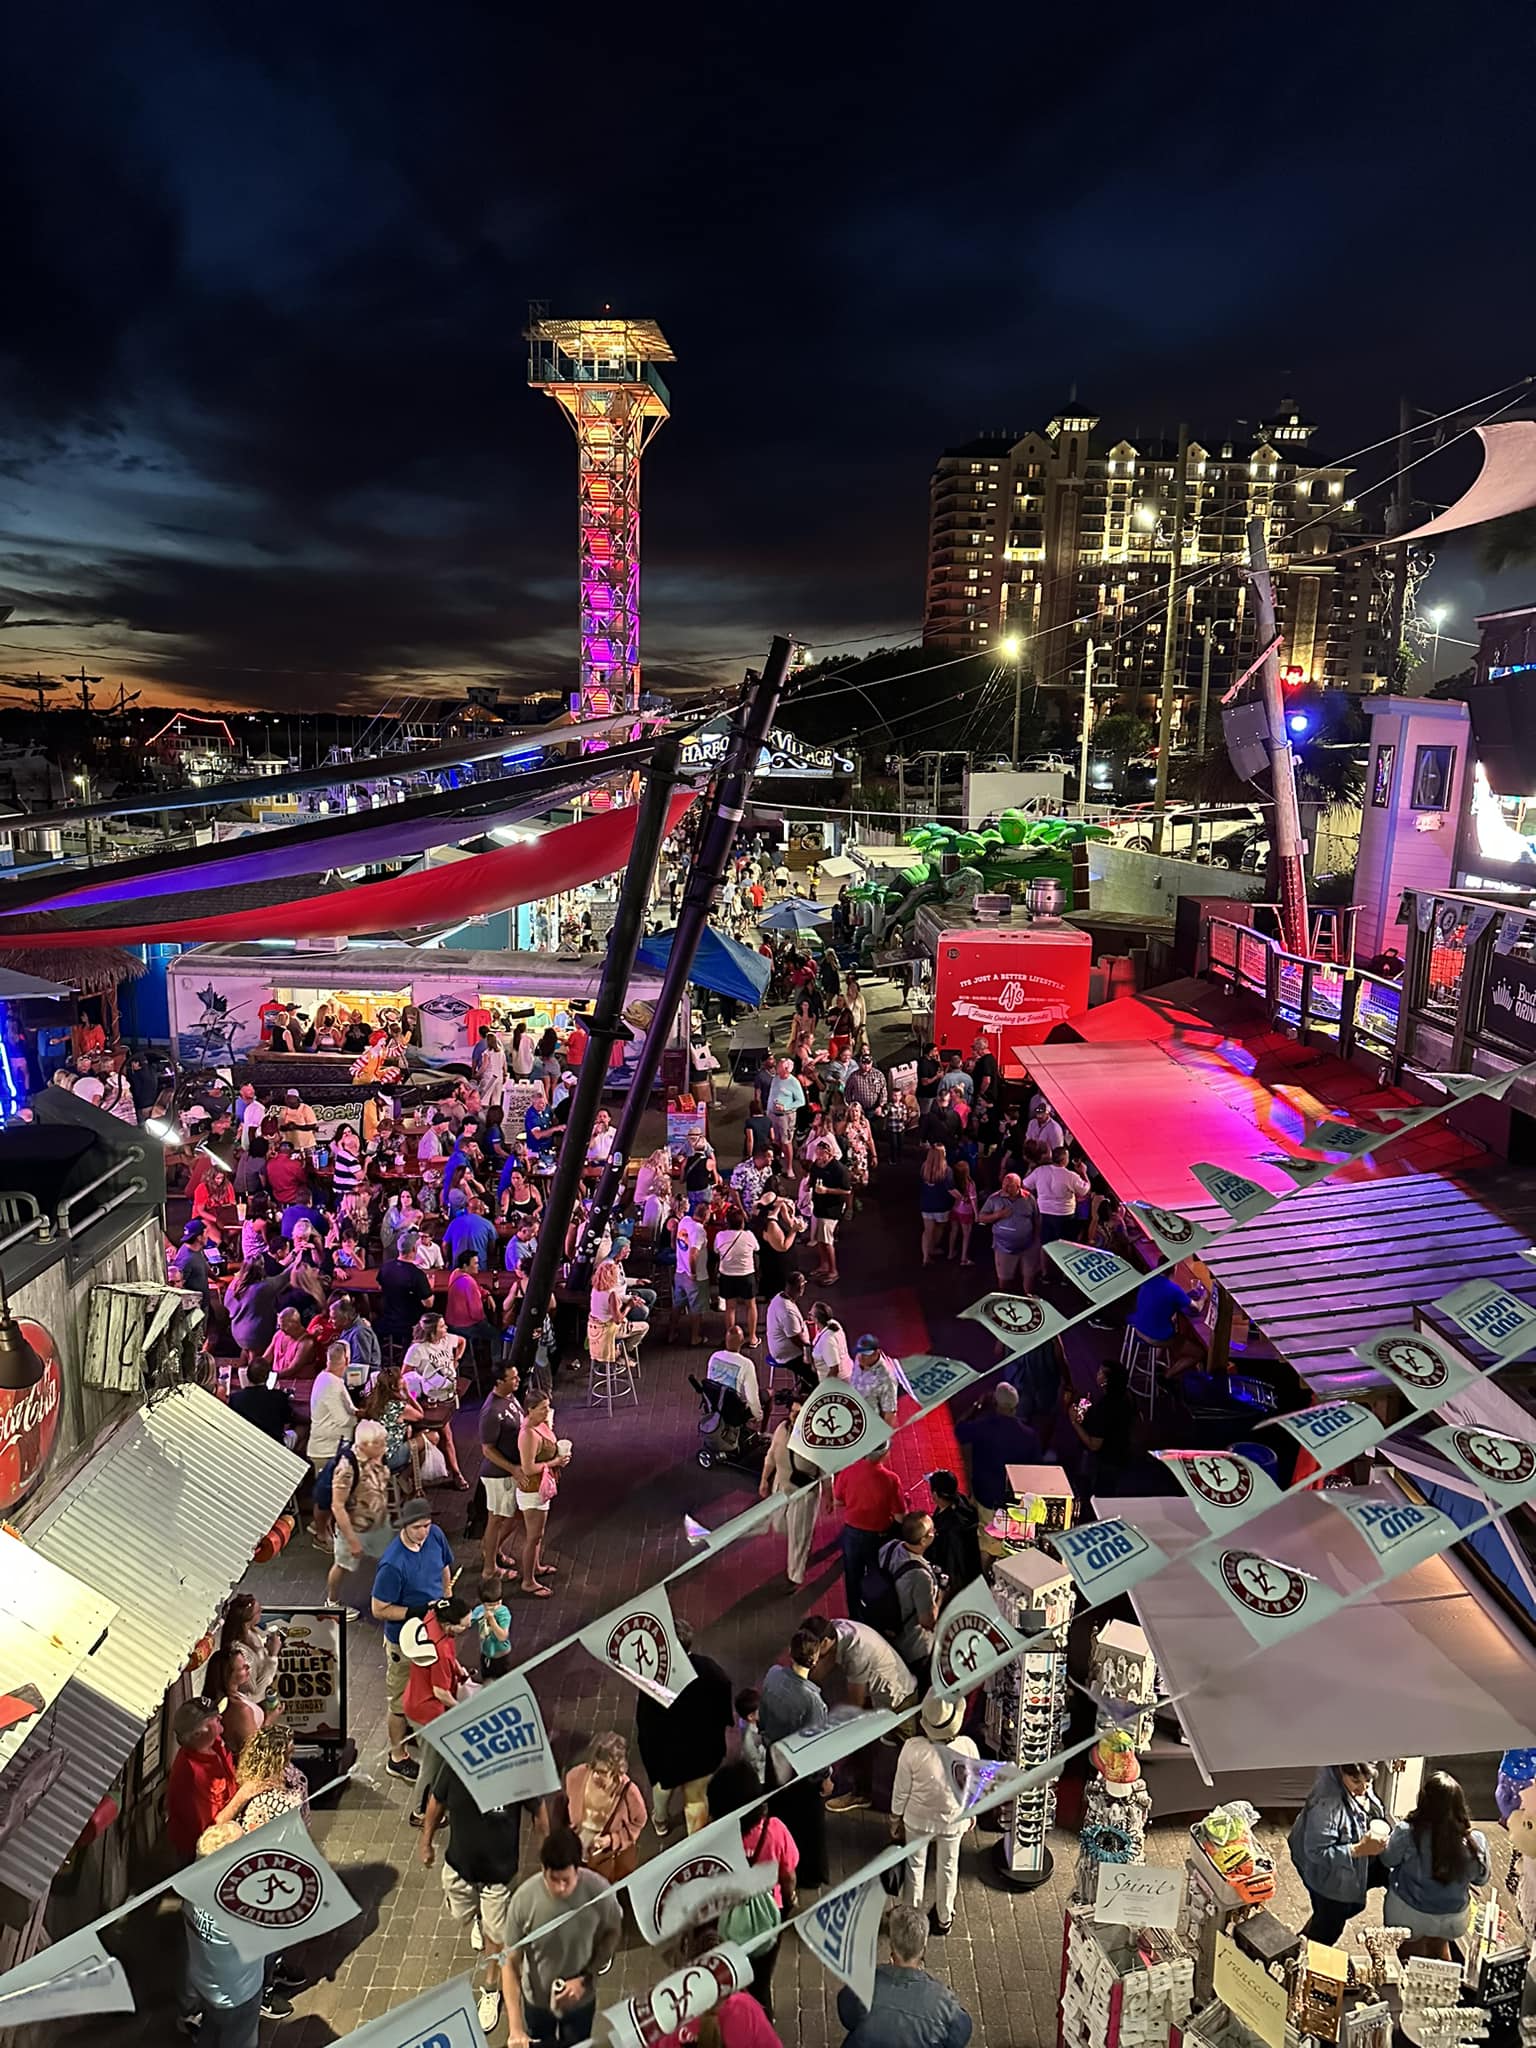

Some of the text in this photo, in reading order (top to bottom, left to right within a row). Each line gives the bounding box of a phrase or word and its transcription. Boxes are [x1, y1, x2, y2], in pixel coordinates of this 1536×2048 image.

[776, 729, 833, 767] VILLAGE
[973, 974, 992, 984] JUST
[993, 973, 1000, 981] A
[1000, 973, 1028, 982] BETTER
[1029, 975, 1066, 991] LIFESTYLE
[312, 1102, 363, 1121] Boat!
[1229, 1183, 1256, 1203] BUD
[1088, 1259, 1122, 1284] BUD
[1467, 1296, 1517, 1332] LIGHT
[1488, 1312, 1526, 1338] BUD
[921, 1369, 957, 1396] BUD
[815, 1409, 863, 1446] ALABAMA
[1313, 1409, 1355, 1438] BUD
[1065, 1520, 1127, 1557] LIGHT
[1380, 1506, 1426, 1540] BUD
[1086, 1534, 1135, 1570] BUD
[609, 1617, 660, 1658] LABAMA
[277, 1656, 329, 1673] ULLET
[277, 1671, 332, 1699] OSS
[460, 1706, 522, 1746] BUD
[461, 1721, 536, 1767] LIGHT
[221, 1855, 301, 1901] ALABAMA
[255, 1872, 296, 1905] A
[1103, 1872, 1177, 1908] Spirit
[236, 1903, 304, 1924] CRIMSON
[1217, 1947, 1281, 2010] Francesca
